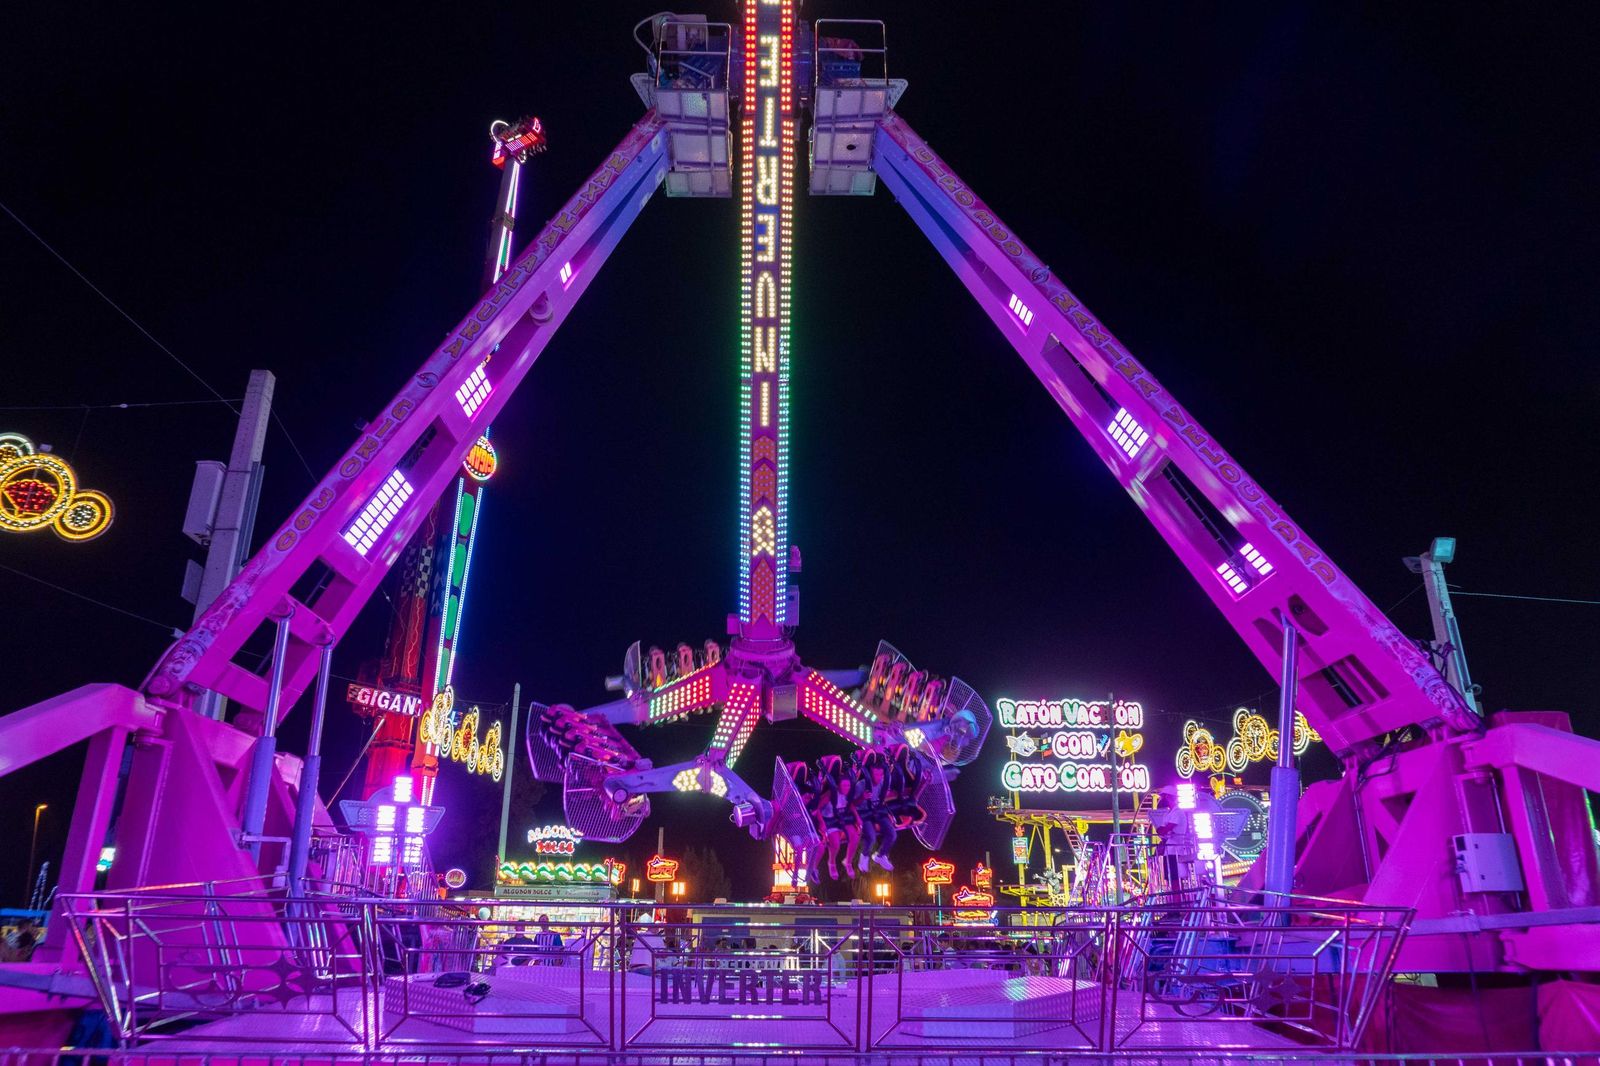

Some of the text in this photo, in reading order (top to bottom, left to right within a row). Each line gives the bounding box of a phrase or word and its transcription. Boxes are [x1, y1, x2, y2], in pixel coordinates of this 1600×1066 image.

[442, 150, 631, 361] MAXIMA ALTURA
[754, 0, 781, 428] INVERTE
[272, 395, 415, 556] GIRO 360
[1050, 288, 1339, 586] MAXIMA VELOCIDAD
[1004, 763, 1058, 790] GATO
[1054, 733, 1096, 756] CON
[660, 969, 822, 1005] INVERTER
